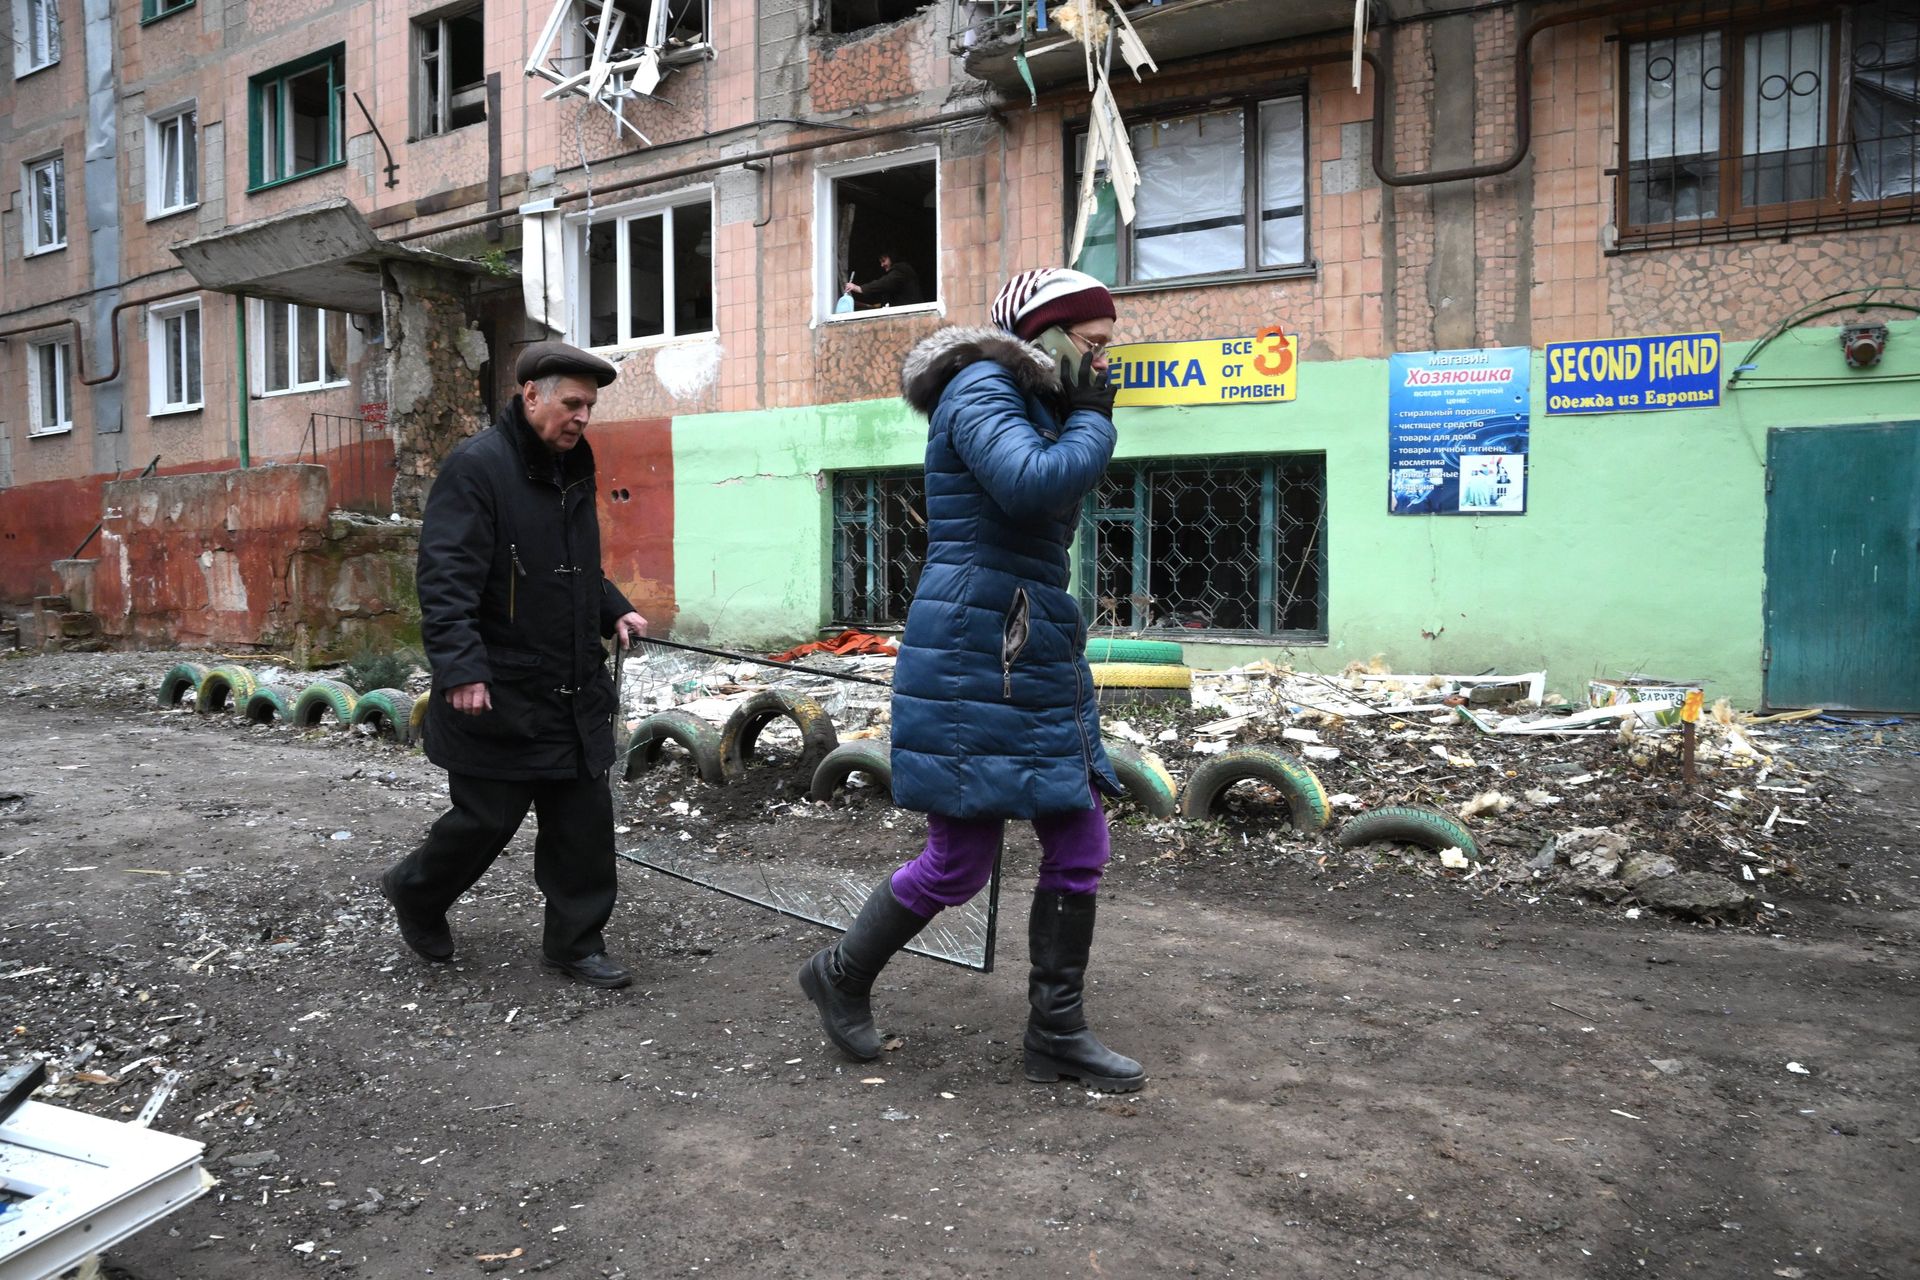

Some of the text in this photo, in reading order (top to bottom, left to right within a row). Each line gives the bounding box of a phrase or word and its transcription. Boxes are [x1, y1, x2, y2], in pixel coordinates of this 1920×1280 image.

[1222, 341, 1253, 355] ВСЕ
[1253, 325, 1293, 377] 3
[1550, 338, 1719, 384] SECOND HAND
[1107, 357, 1207, 390] ЁШКА
[1222, 365, 1244, 378] ОТ
[1406, 368, 1512, 385] Хозяюшка
[1221, 384, 1285, 399] ГРИВЕН
[1413, 390, 1442, 398] всегда
[1456, 387, 1504, 397] доступной
[1550, 389, 1714, 409] Одежда из Европы
[1399, 408, 1497, 418] стиральный порошок
[1399, 420, 1484, 431] чистящее средство
[1399, 433, 1477, 443] товары для дома
[1399, 447, 1431, 455] товары
[1433, 445, 1466, 453] личной
